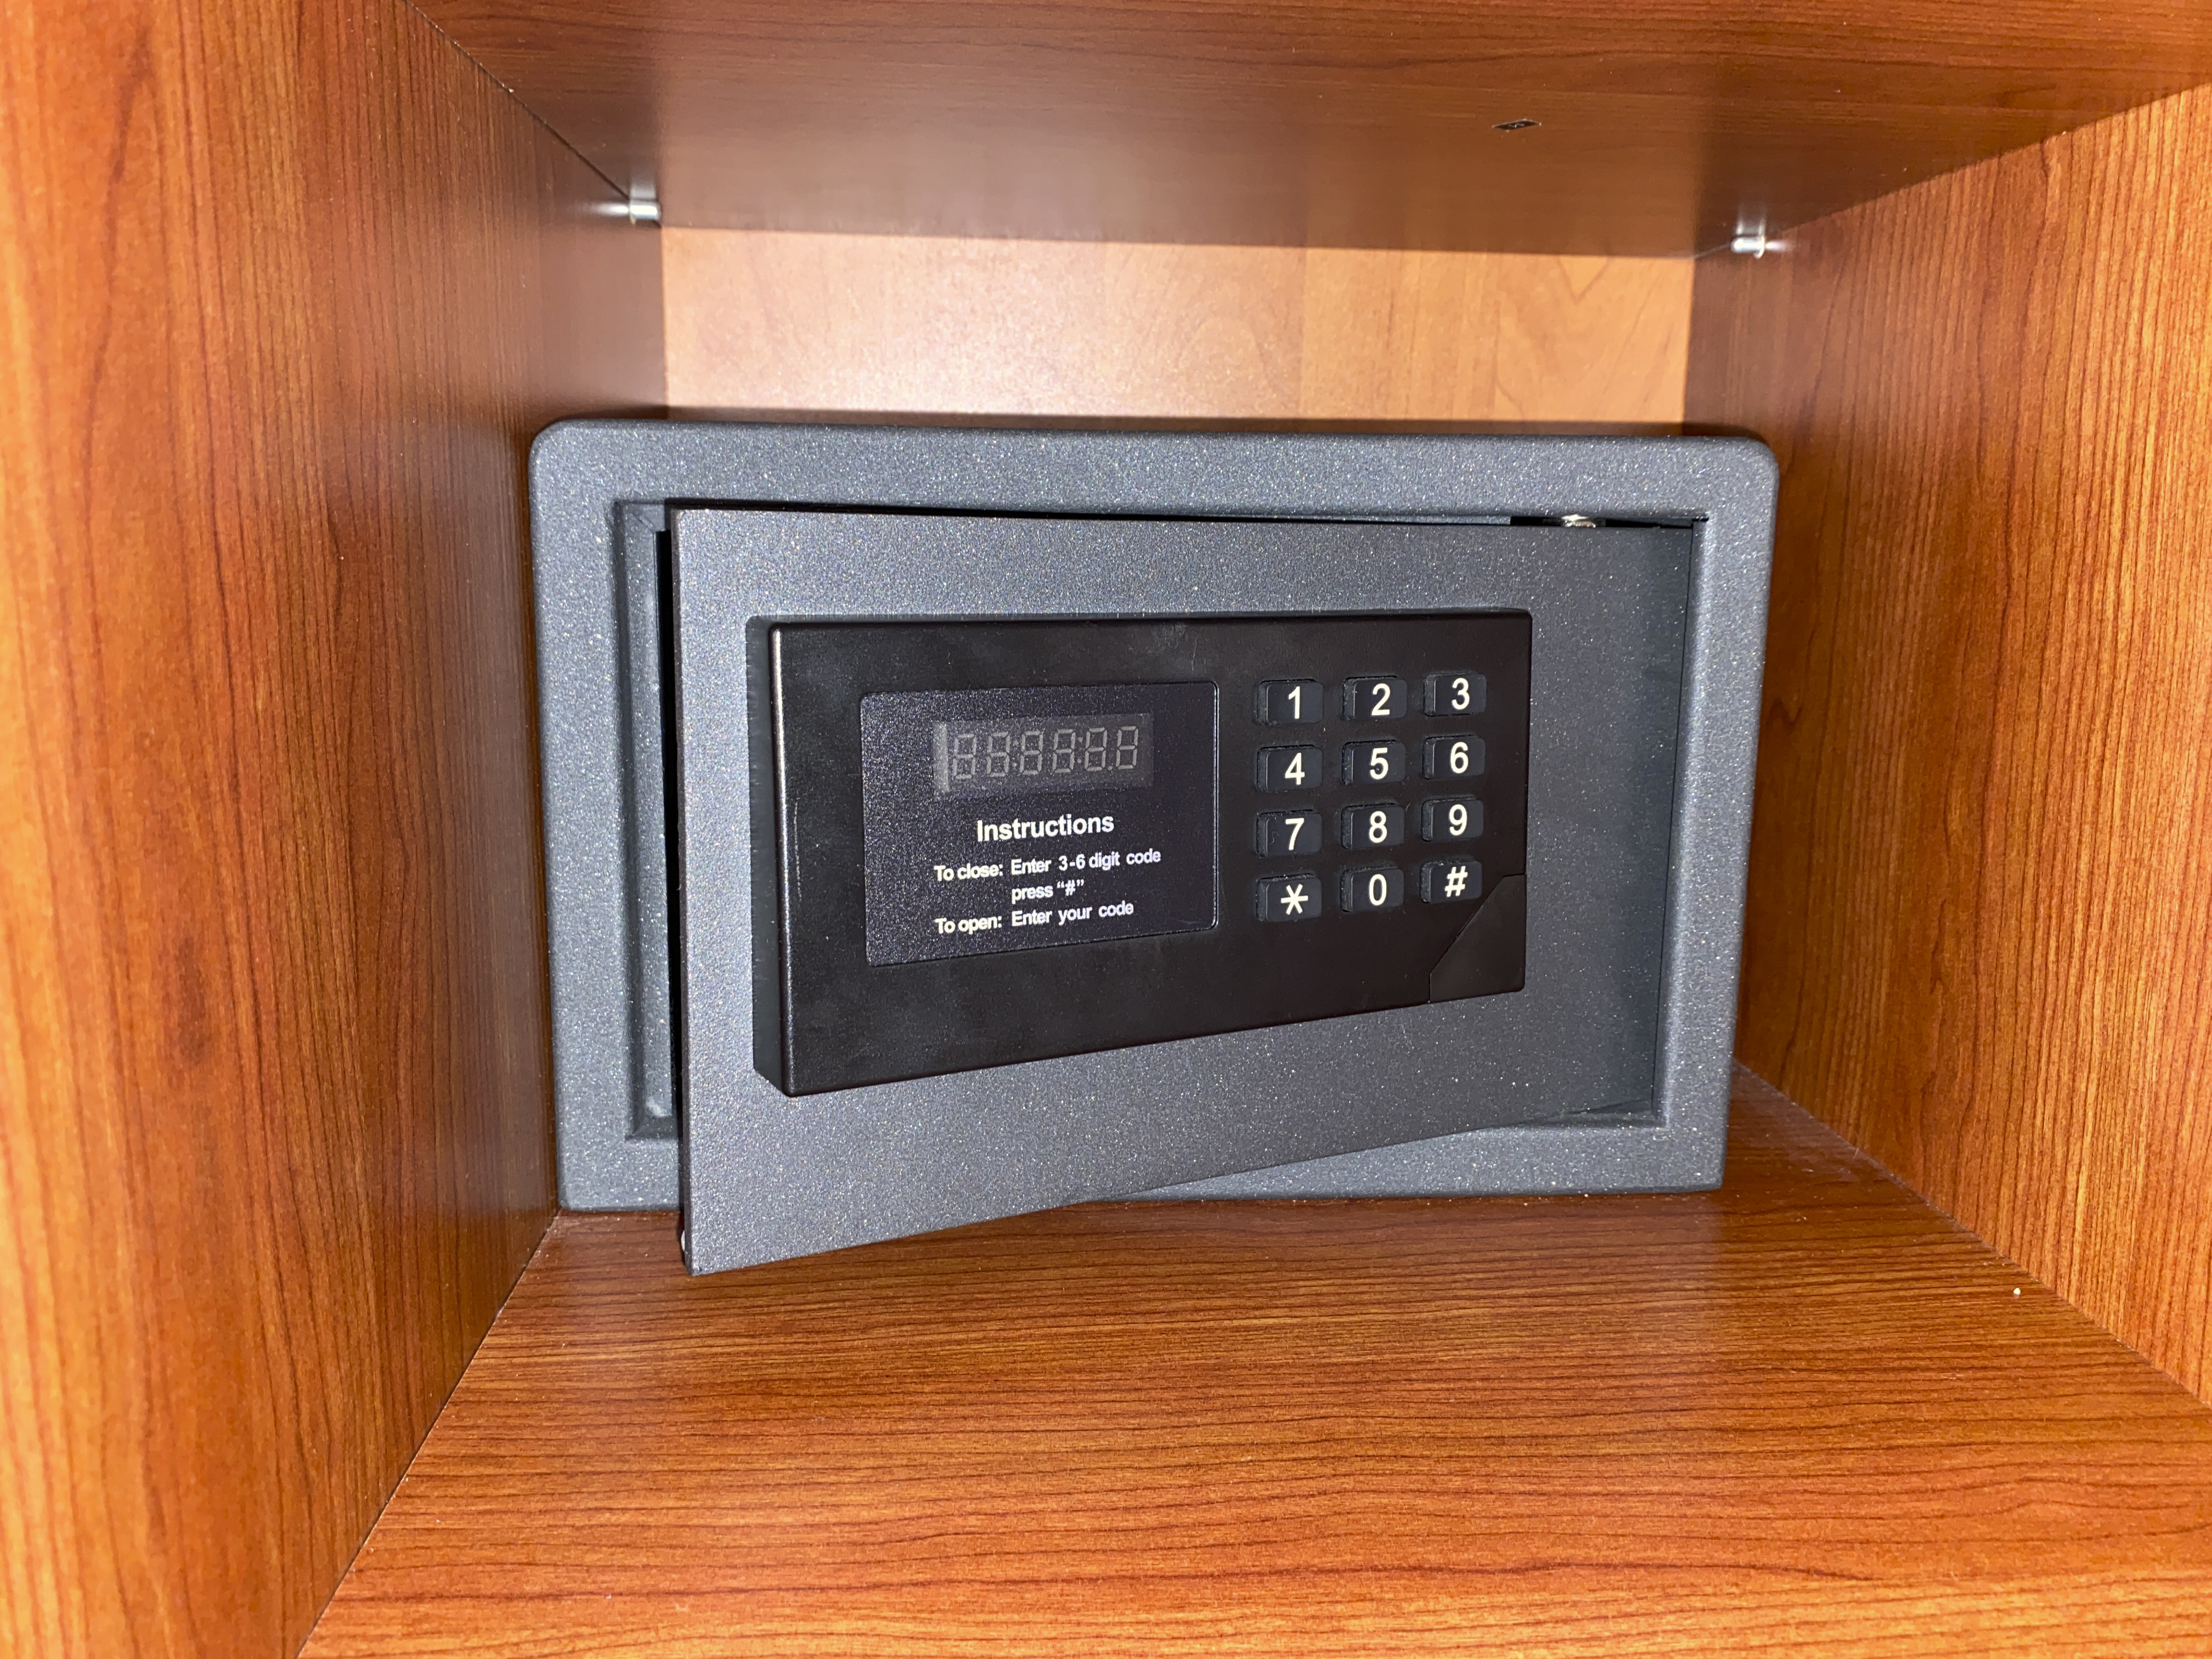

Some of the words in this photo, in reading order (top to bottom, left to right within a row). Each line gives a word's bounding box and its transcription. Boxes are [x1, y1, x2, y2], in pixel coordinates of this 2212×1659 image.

[1288, 686, 1300, 719] 1
[1371, 683, 1391, 716] 2
[1451, 678, 1470, 710] 3
[1284, 752, 1305, 786] 4
[1369, 747, 1389, 780] 5
[1449, 741, 1469, 774] 6
[977, 814, 1114, 843] Instructions
[1285, 817, 1305, 851] 7
[1368, 810, 1387, 844] 8
[1448, 804, 1468, 836] 9
[934, 865, 955, 882] To
[957, 862, 1003, 880] close:
[1011, 858, 1052, 876] Enter
[1058, 854, 1086, 871] 3-6
[1088, 851, 1120, 871] digit
[1126, 848, 1161, 865] code
[1444, 865, 1468, 898] #
[1011, 885, 1054, 905] press
[1368, 873, 1387, 906] 0
[934, 917, 956, 934] To
[957, 915, 1003, 935] open:
[1011, 909, 1053, 927] Enter
[1058, 906, 1093, 926] your
[1098, 900, 1134, 918] code
